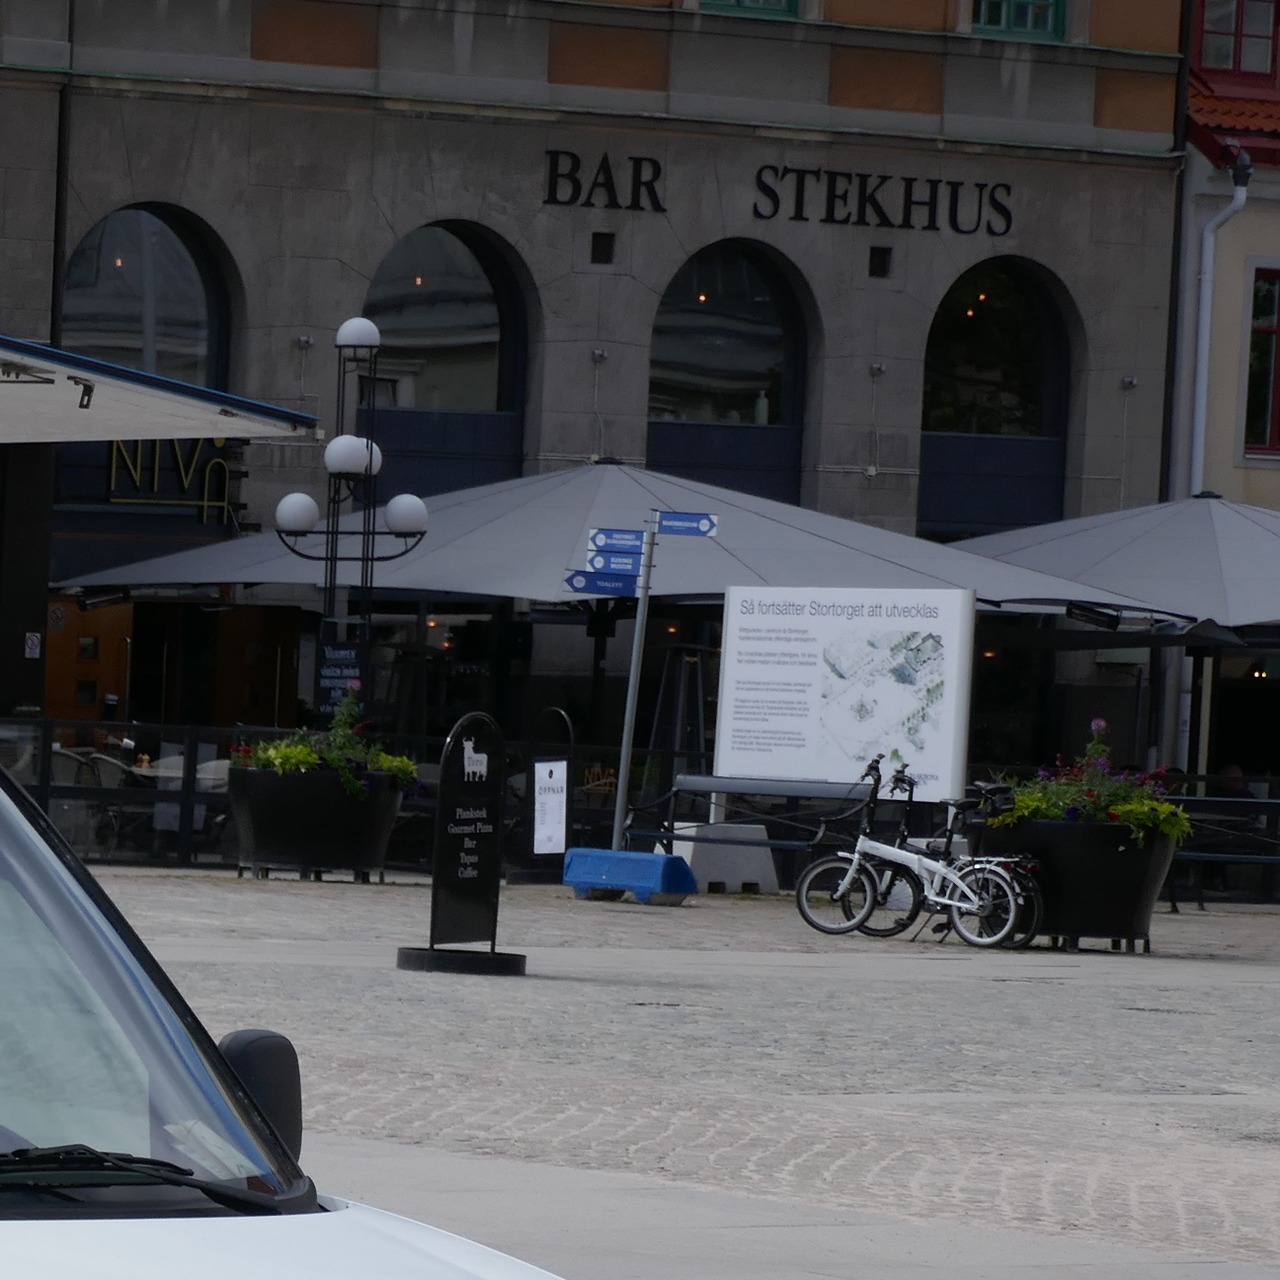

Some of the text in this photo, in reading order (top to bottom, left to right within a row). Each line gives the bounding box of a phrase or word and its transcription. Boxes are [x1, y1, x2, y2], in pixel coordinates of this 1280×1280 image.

[543, 149, 1013, 237] BAR STEKHUS
[740, 599, 939, 620] Så fortsätter Stortorget att utvecklas
[447, 824, 475, 834] Gourmet
[463, 837, 477, 849] Bar
[458, 867, 478, 878] Coffee
